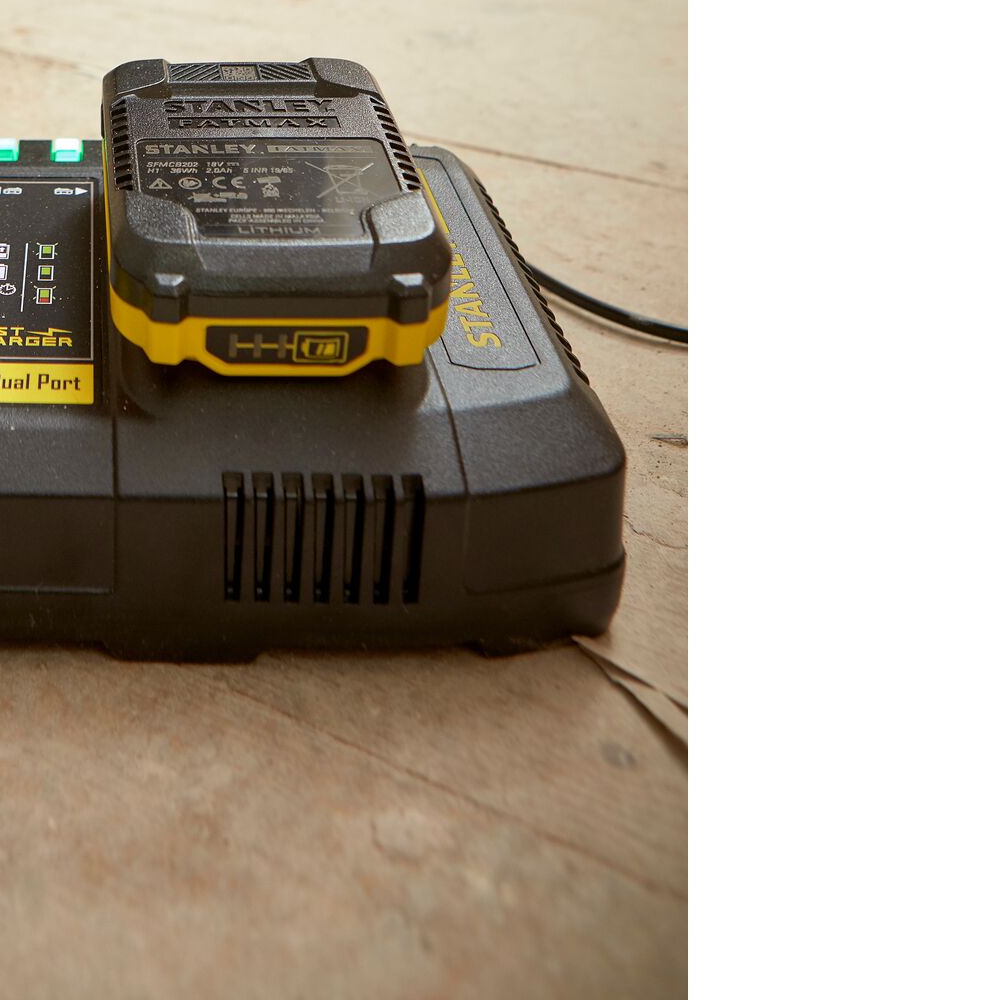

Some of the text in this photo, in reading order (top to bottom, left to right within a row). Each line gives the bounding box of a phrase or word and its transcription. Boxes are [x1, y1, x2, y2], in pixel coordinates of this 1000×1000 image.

[163, 100, 335, 113] STANLEY
[178, 118, 329, 127] FATMAX
[145, 144, 256, 154] STANLEY
[237, 226, 321, 234] LITHIUM
[449, 240, 503, 349] STANL
[37, 371, 81, 391] Port
